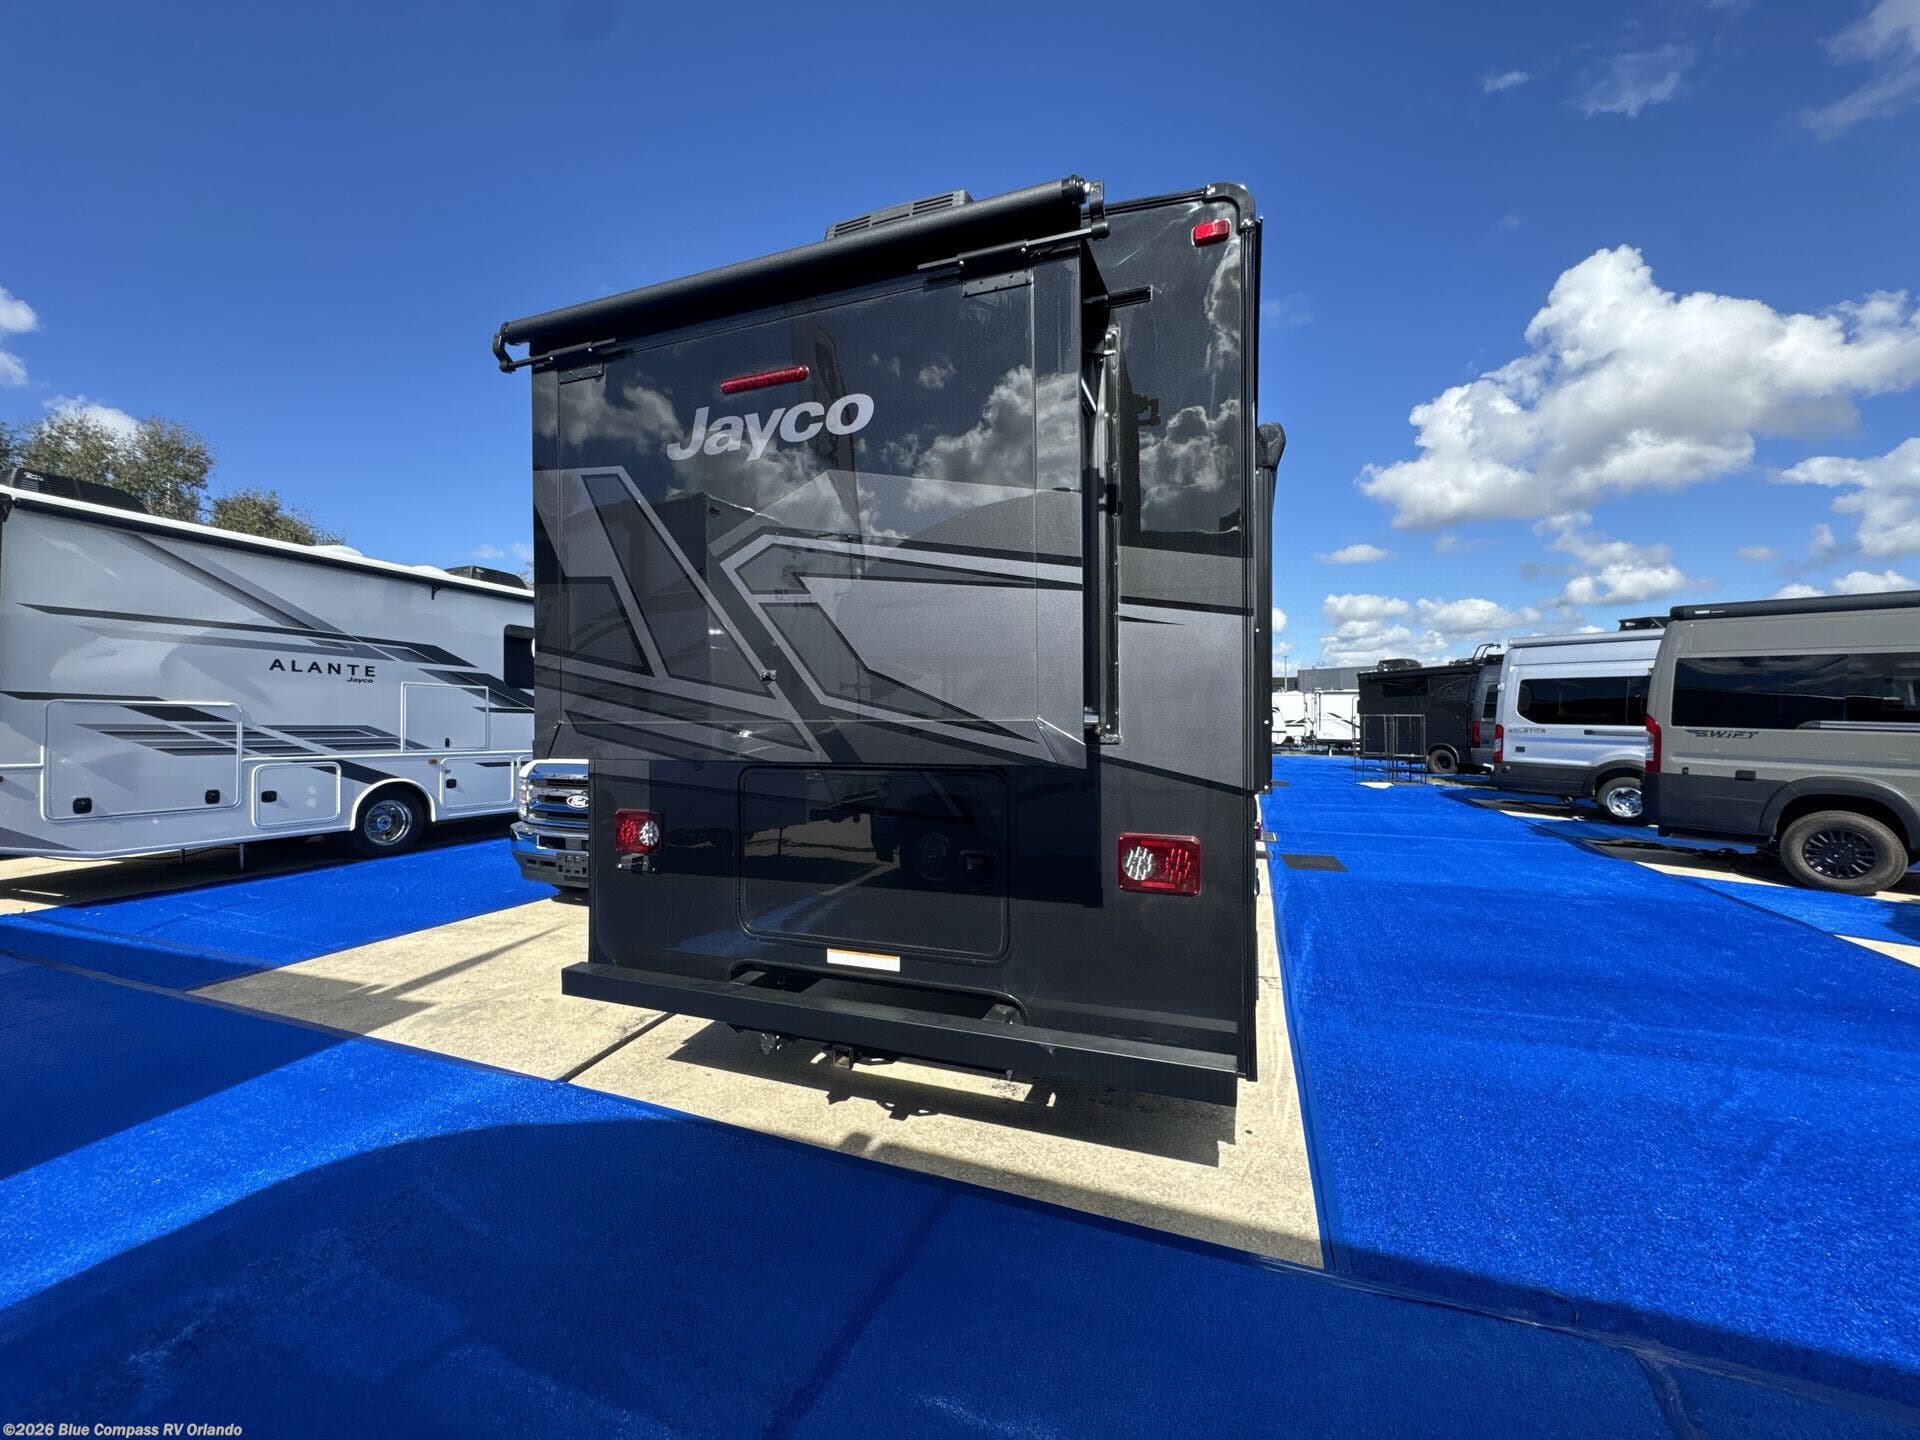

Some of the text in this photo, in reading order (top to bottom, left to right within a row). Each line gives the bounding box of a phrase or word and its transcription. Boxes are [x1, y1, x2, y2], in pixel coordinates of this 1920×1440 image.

[666, 393, 875, 461] Jayco
[269, 658, 376, 677] ALANTE
[346, 676, 374, 684] Jayco
